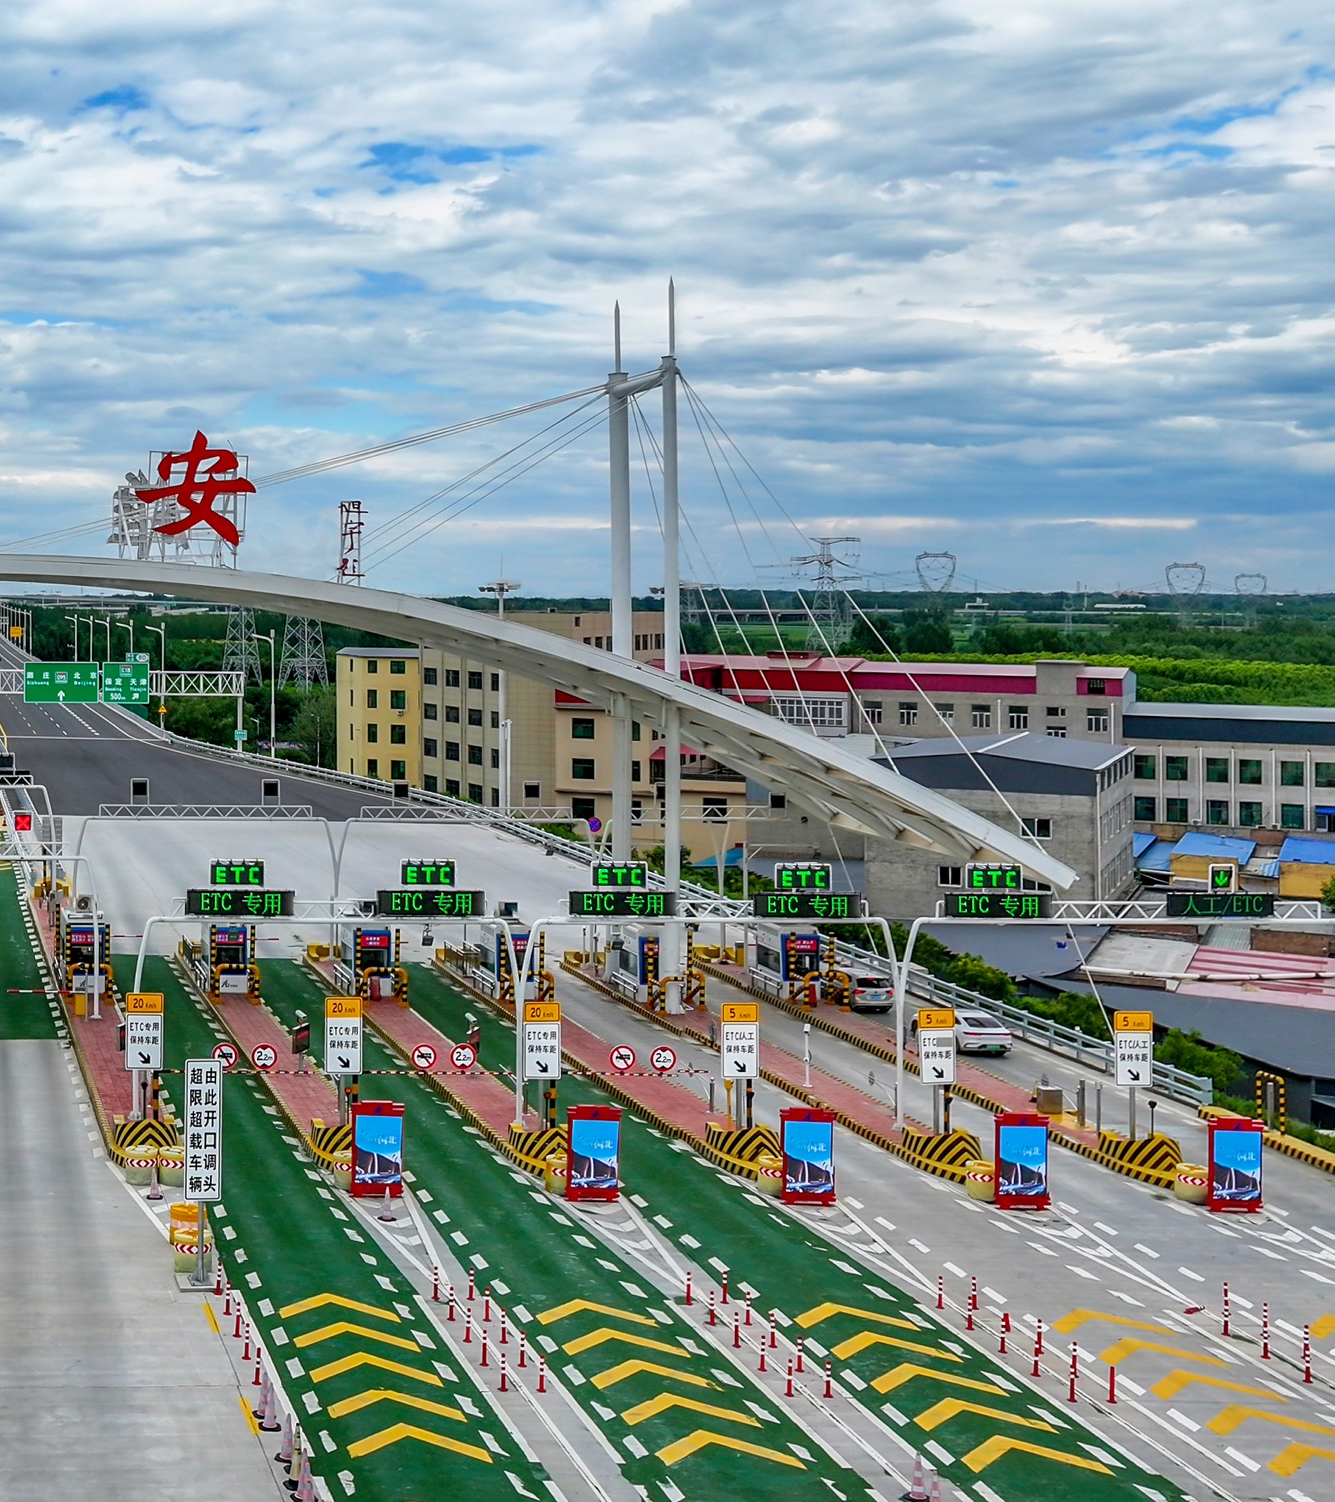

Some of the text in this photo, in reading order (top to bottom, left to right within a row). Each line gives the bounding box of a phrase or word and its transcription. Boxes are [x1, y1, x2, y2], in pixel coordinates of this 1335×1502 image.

[135, 429, 257, 547] 安
[73, 672, 97, 680] 北京
[216, 866, 260, 883] ETC
[407, 866, 450, 883] ETC
[598, 868, 642, 884] ETC
[782, 871, 826, 886] ETC
[973, 871, 1016, 886] ETC
[201, 892, 281, 914] ETC 专用
[392, 892, 472, 914] ETC 专用
[583, 893, 664, 914] ETC 专用
[768, 896, 848, 917] ETC 专用
[958, 896, 1038, 916] ETC 专用
[1181, 895, 1263, 915] 人工/ETC
[133, 998, 144, 1008] 20
[332, 1003, 343, 1013] 20
[530, 1008, 541, 1018] 20
[730, 1008, 736, 1018] 5
[926, 1014, 933, 1024] 5
[1123, 1016, 1129, 1026] 5
[130, 1022, 159, 1031] ETC专用
[330, 1026, 358, 1035] ETC专用
[130, 1036, 159, 1045] 保持车距
[528, 1031, 556, 1040] ETC专用
[330, 1040, 358, 1049] 保持车距
[528, 1045, 556, 1054] 保持车距
[726, 1045, 754, 1054] 保持车距
[924, 1050, 952, 1060] 保持车距
[1120, 1053, 1148, 1062] 保持车距
[189, 1068, 203, 1193] 超限超载车辆
[203, 1067, 217, 1193] 由此开口调头
